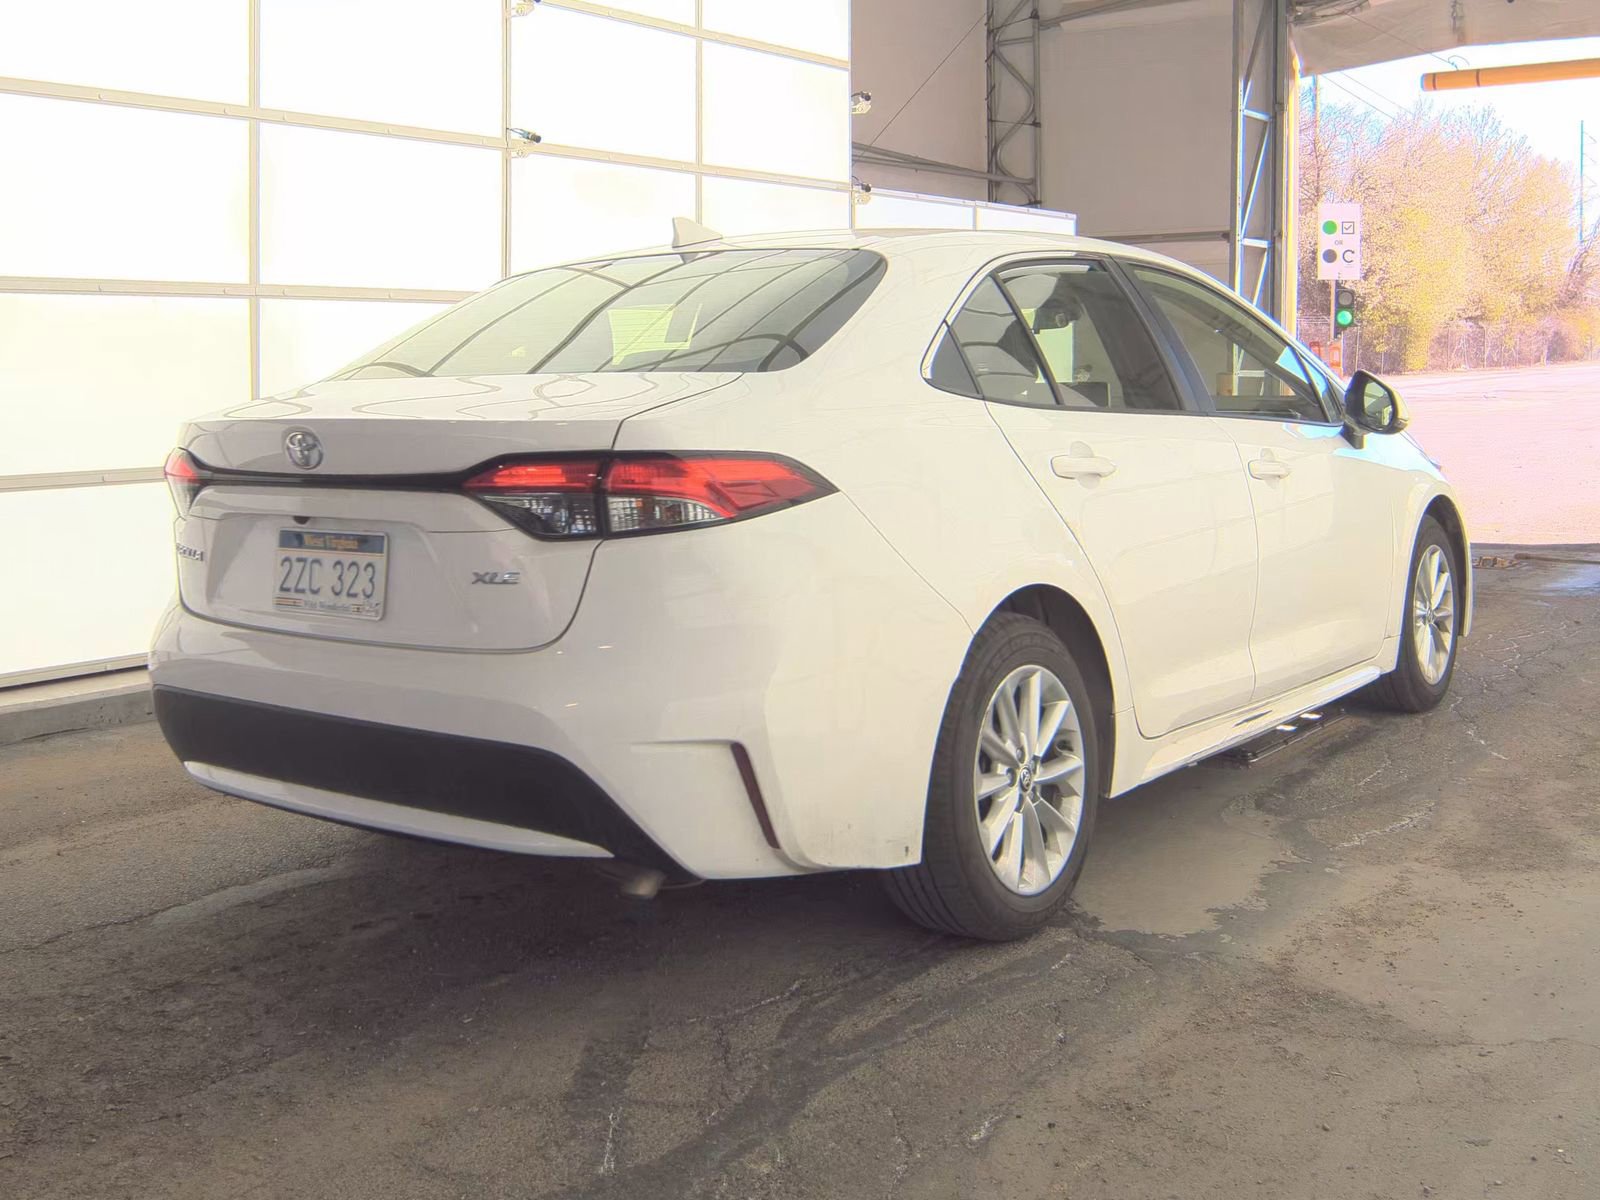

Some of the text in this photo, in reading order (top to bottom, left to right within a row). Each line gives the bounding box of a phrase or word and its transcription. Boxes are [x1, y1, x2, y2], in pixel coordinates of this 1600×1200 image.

[279, 556, 376, 599] 2ZC 323
[471, 571, 521, 585] XLE
